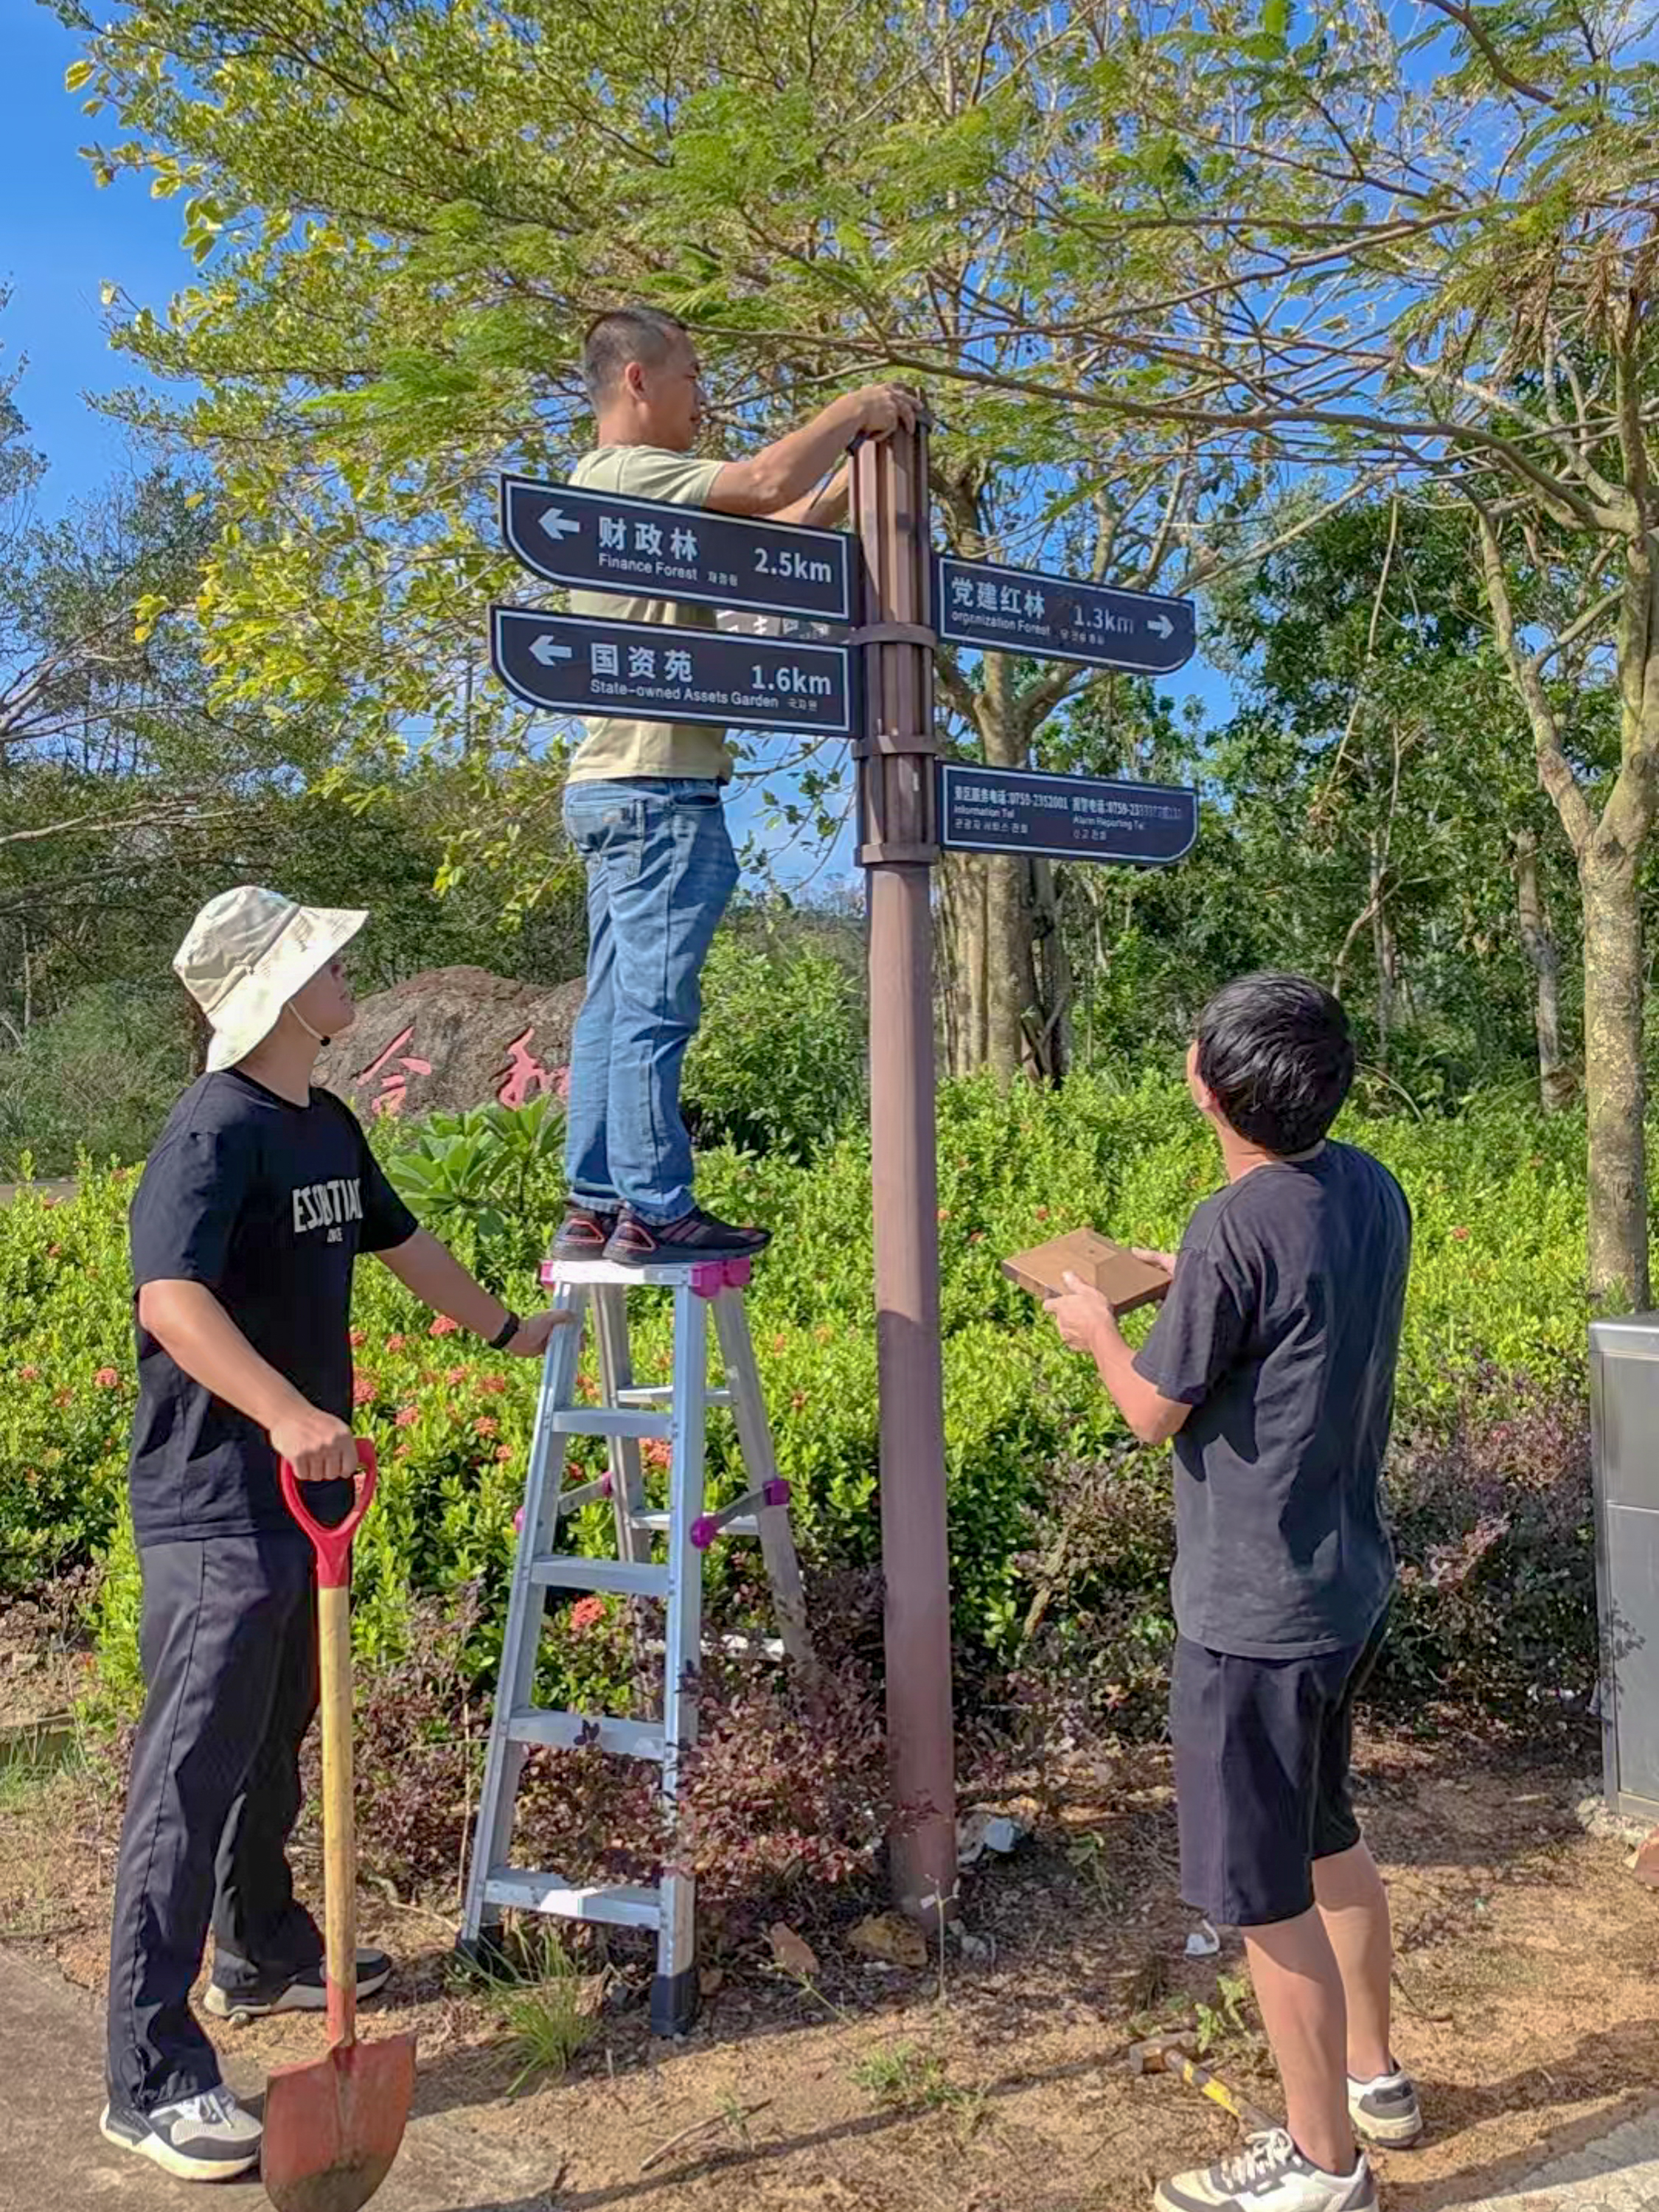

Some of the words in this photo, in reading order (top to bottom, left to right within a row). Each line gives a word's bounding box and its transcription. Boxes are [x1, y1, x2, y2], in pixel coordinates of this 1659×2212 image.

[598, 516, 698, 562] 财政林
[598, 553, 653, 574] Finance
[655, 562, 698, 581] Forest
[754, 547, 832, 583] 2.5km
[950, 577, 1046, 619] 党建红林
[1017, 620, 1051, 636] Forest
[1074, 605, 1134, 634] 1.3km
[591, 642, 694, 684] 国资苑
[590, 679, 681, 700] State-owned
[684, 688, 728, 704] Assets
[731, 692, 779, 709] Garden
[751, 664, 832, 695] 1.6km
